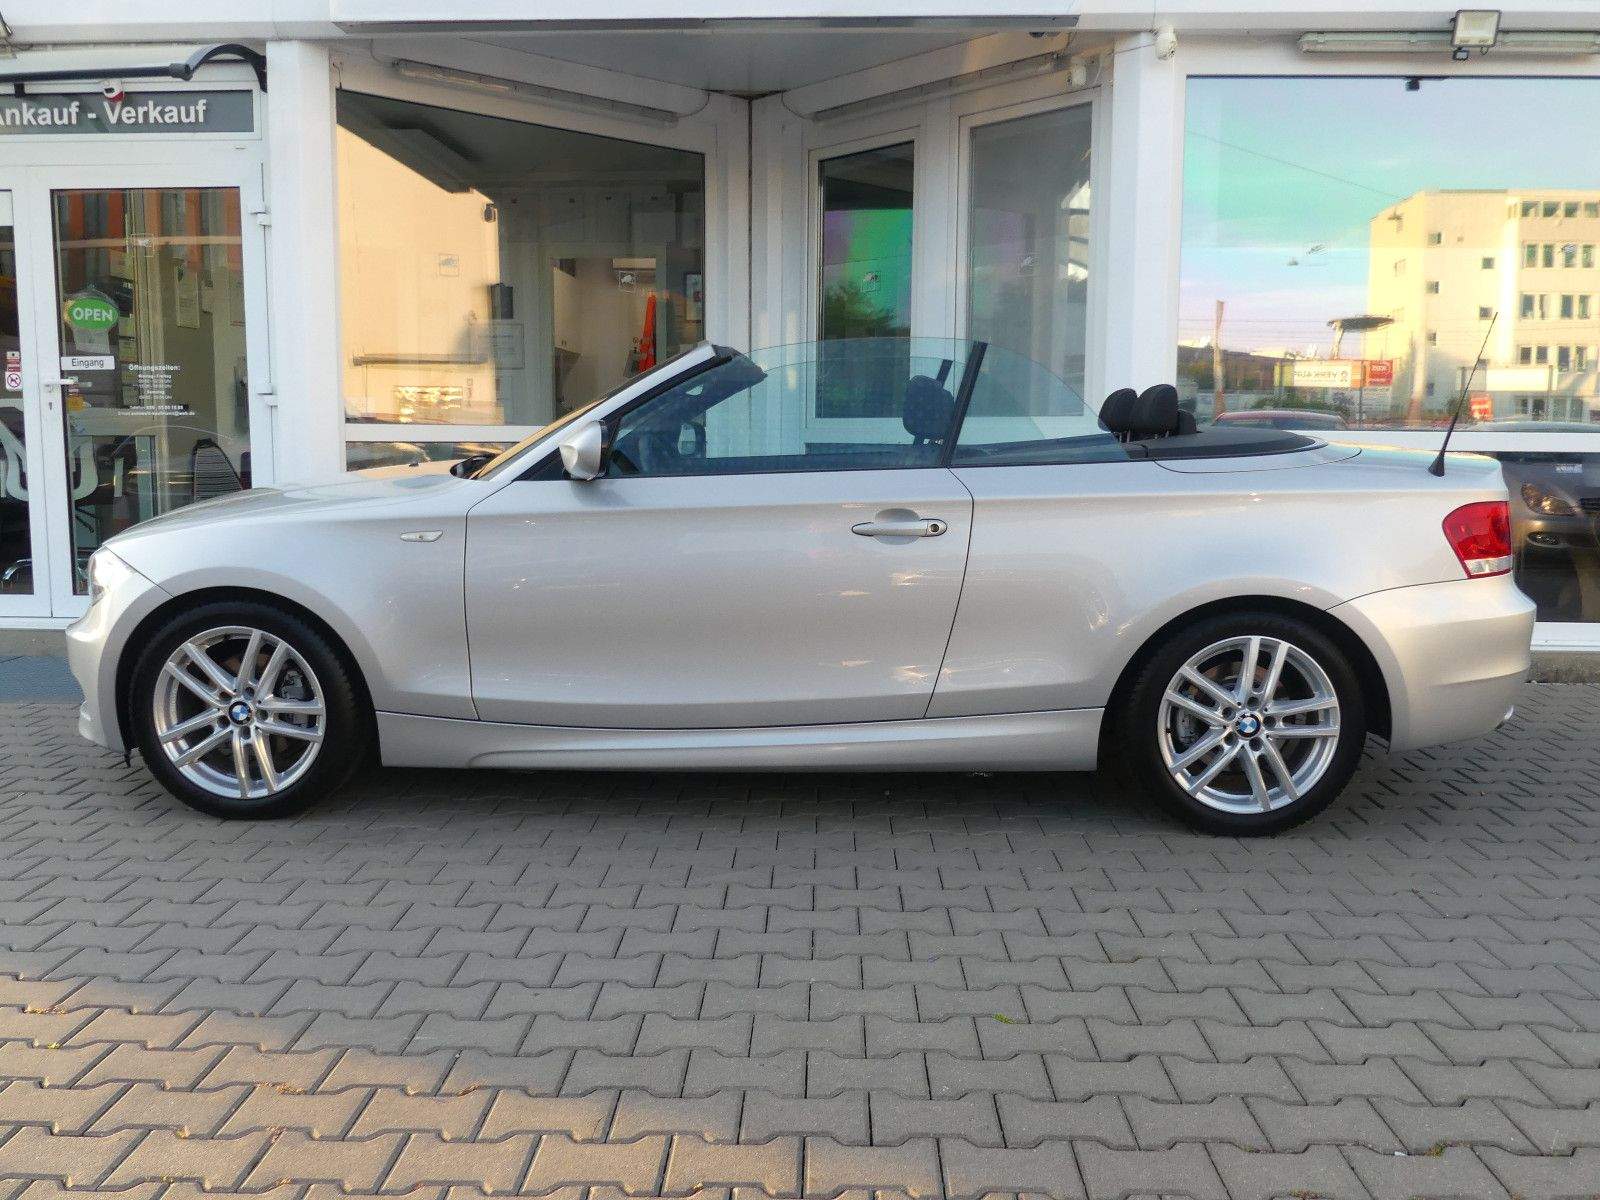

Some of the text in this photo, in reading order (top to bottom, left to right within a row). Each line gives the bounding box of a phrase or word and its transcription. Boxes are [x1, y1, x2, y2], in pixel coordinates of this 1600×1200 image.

[0, 101, 80, 126] nkauf
[103, 99, 207, 125] Verkauf
[72, 307, 113, 321] OPEN
[71, 358, 104, 368] Eingang
